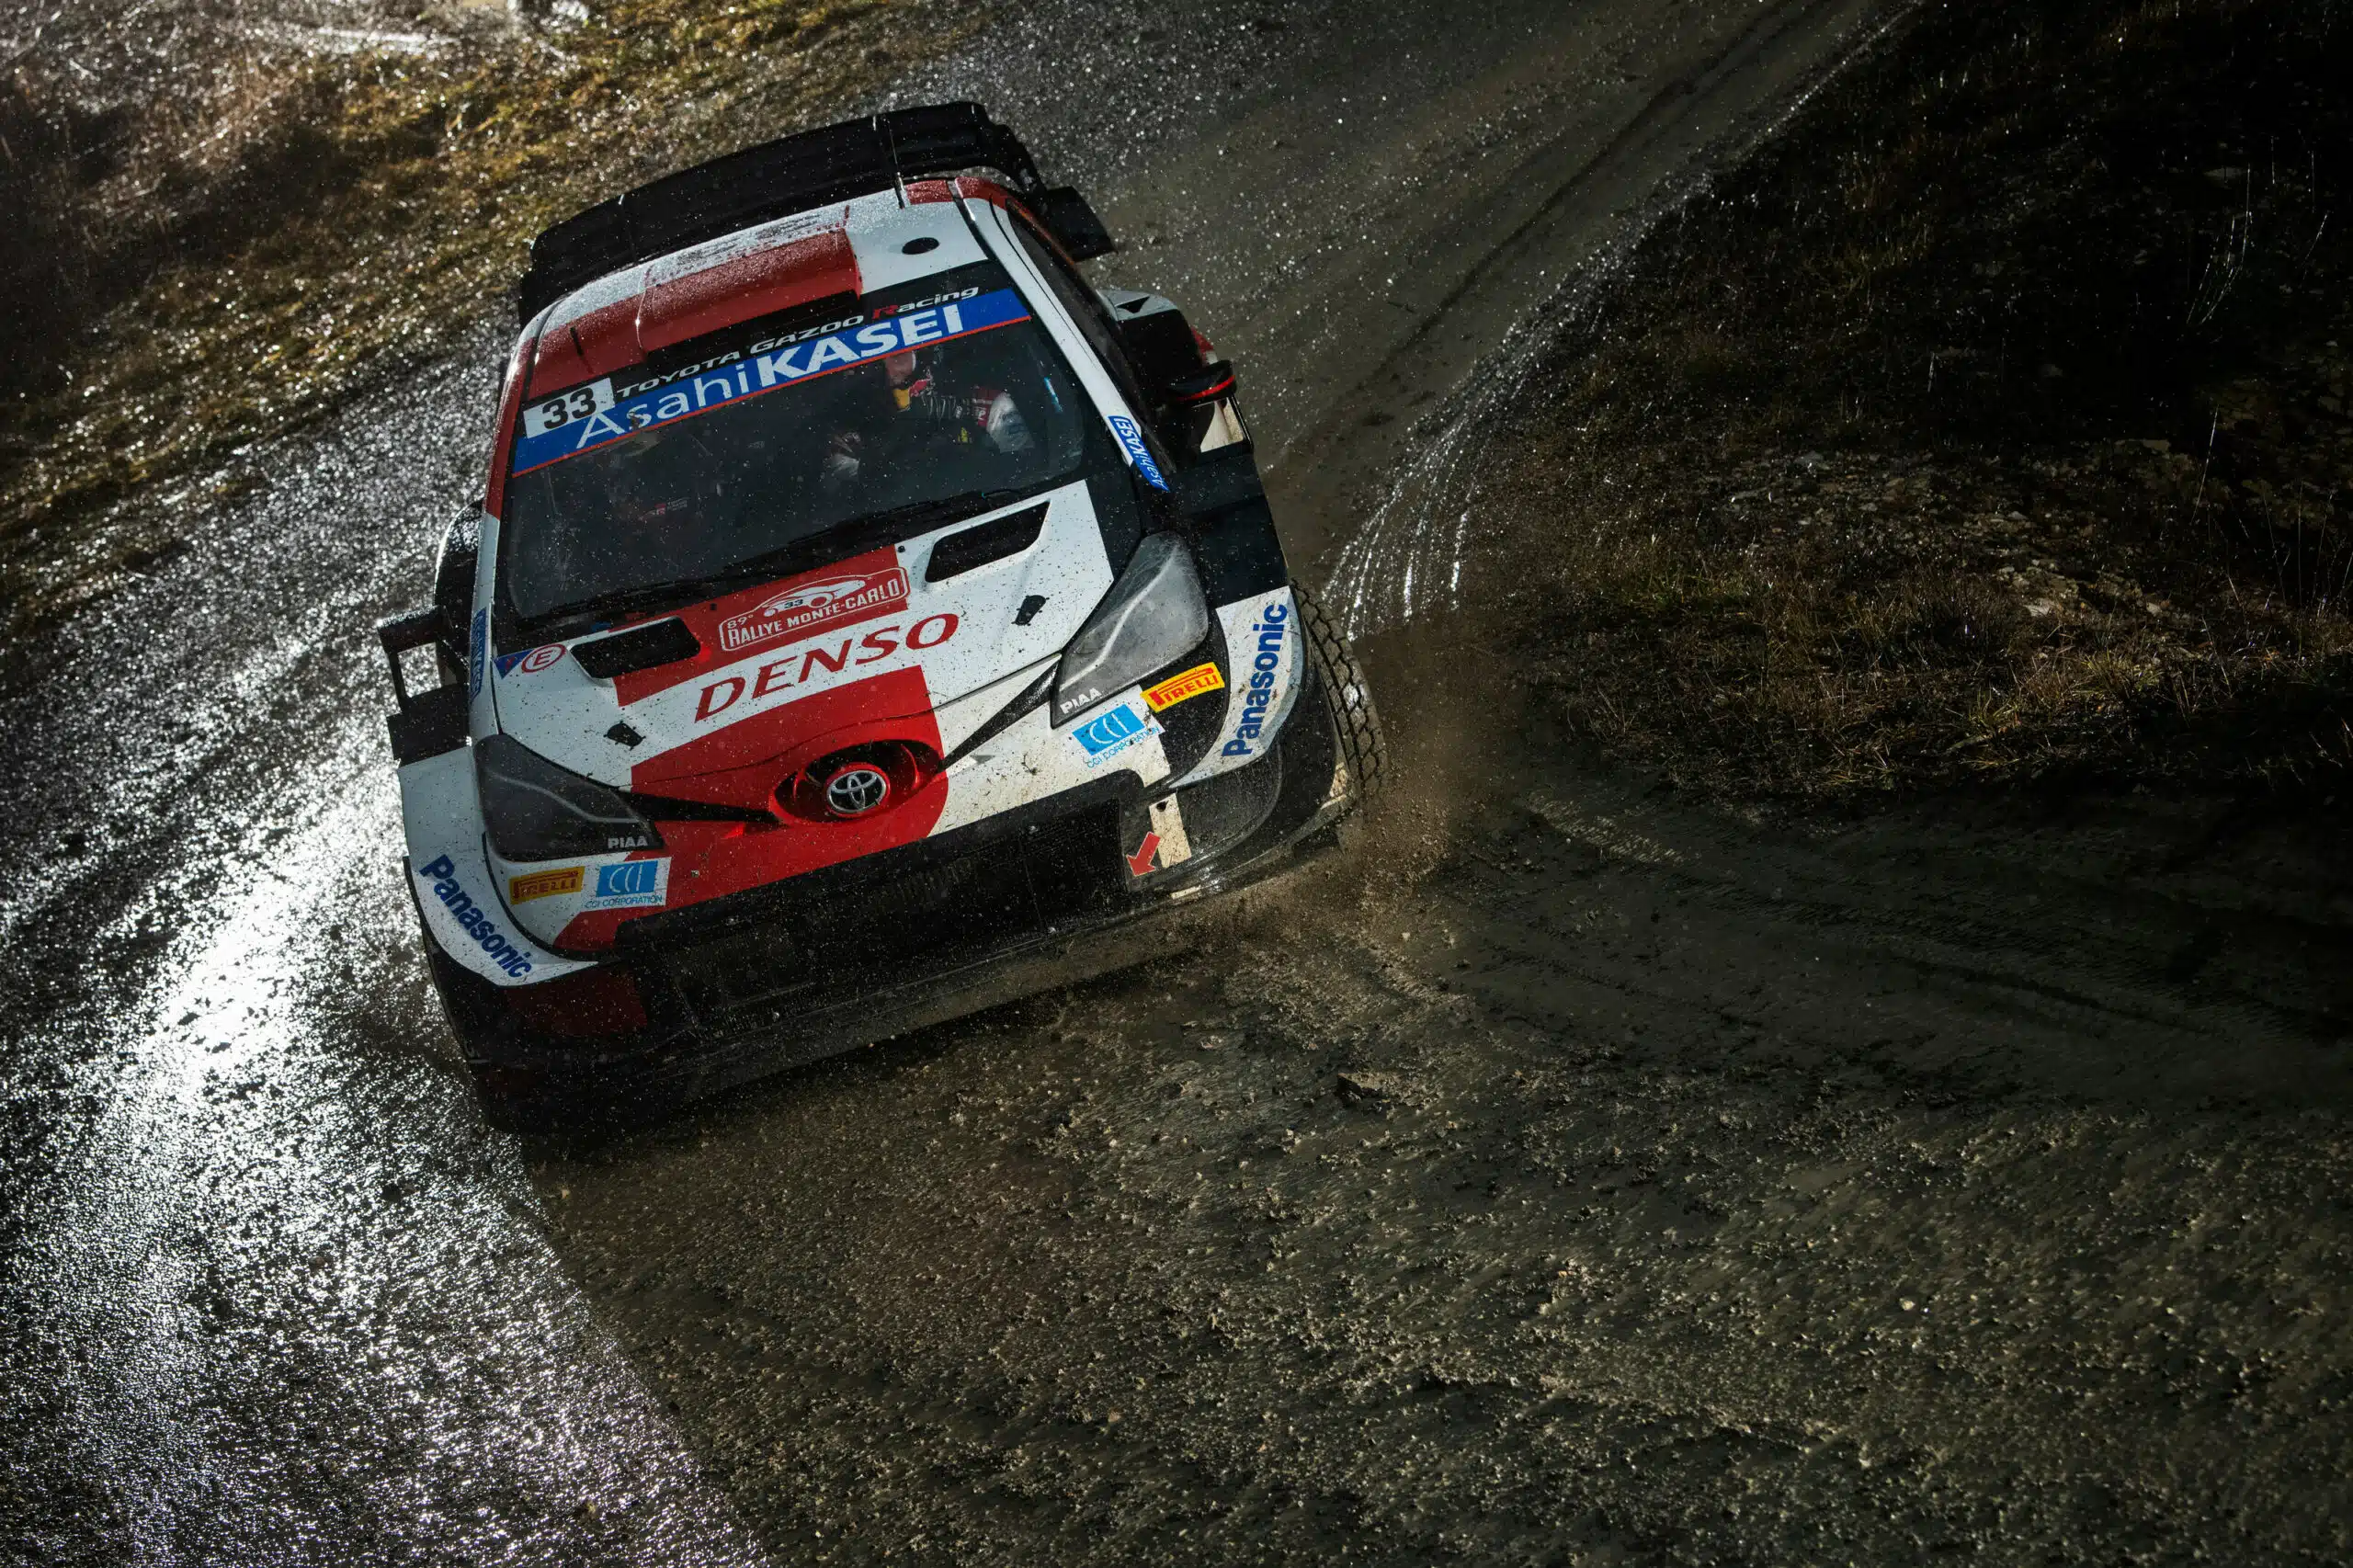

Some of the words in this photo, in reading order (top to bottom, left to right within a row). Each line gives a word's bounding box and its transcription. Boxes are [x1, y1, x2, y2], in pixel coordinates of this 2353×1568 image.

[615, 351, 740, 398] TOYOTA
[750, 315, 864, 355] GAZOO
[872, 286, 980, 320] Racing
[542, 387, 597, 430] 33
[727, 619, 782, 648] RALLYE
[787, 577, 901, 629] MONTE-CARLO
[784, 598, 804, 608] 33
[694, 613, 960, 724] DENSO
[1148, 666, 1220, 707] PIRELLI
[1221, 604, 1288, 756] Panasonic
[1059, 687, 1102, 714] PIAA
[1102, 727, 1161, 759] CORPORATION
[608, 835, 649, 848] PIAA
[512, 870, 579, 899] PIRELLI
[602, 894, 664, 907] CORPORATION
[419, 854, 532, 978] Panasonic
